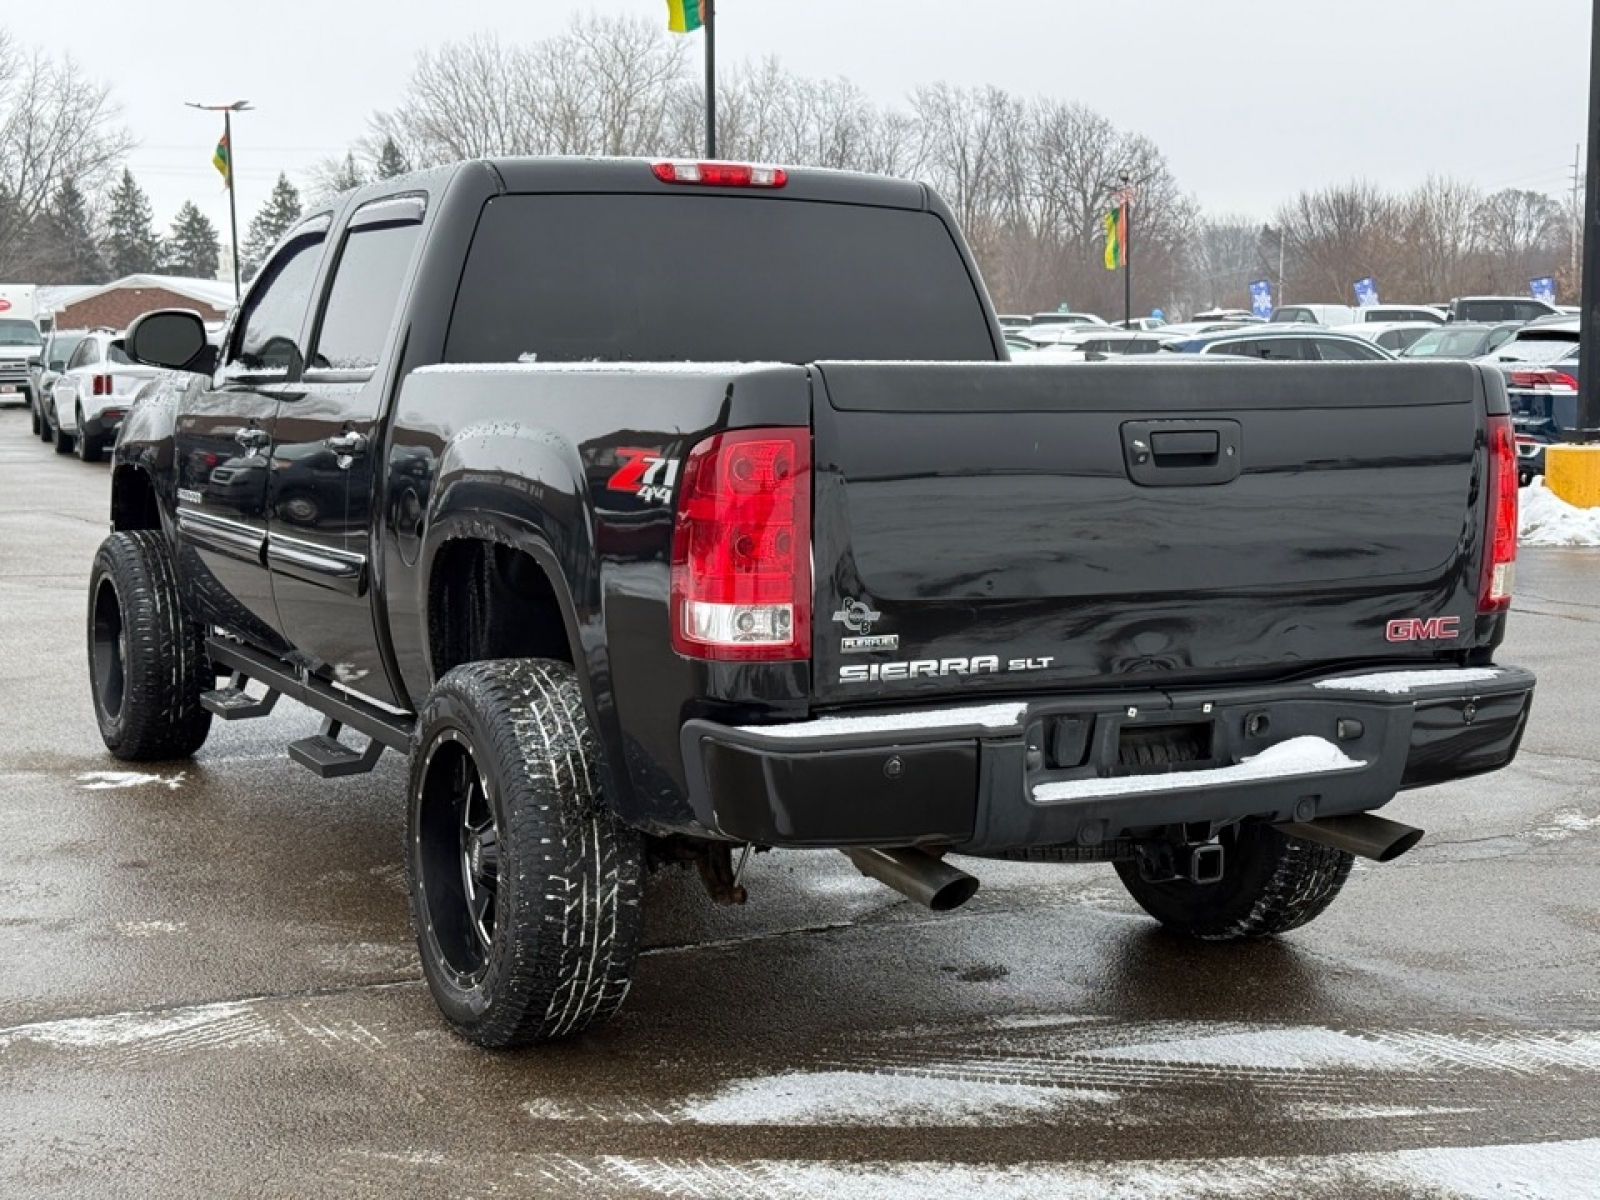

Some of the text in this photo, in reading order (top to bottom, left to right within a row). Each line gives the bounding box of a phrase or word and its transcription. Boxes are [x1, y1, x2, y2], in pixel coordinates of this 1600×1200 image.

[608, 447, 680, 492] Z71
[1387, 616, 1460, 642] GMC
[839, 655, 1055, 684] SIERRA SLT
